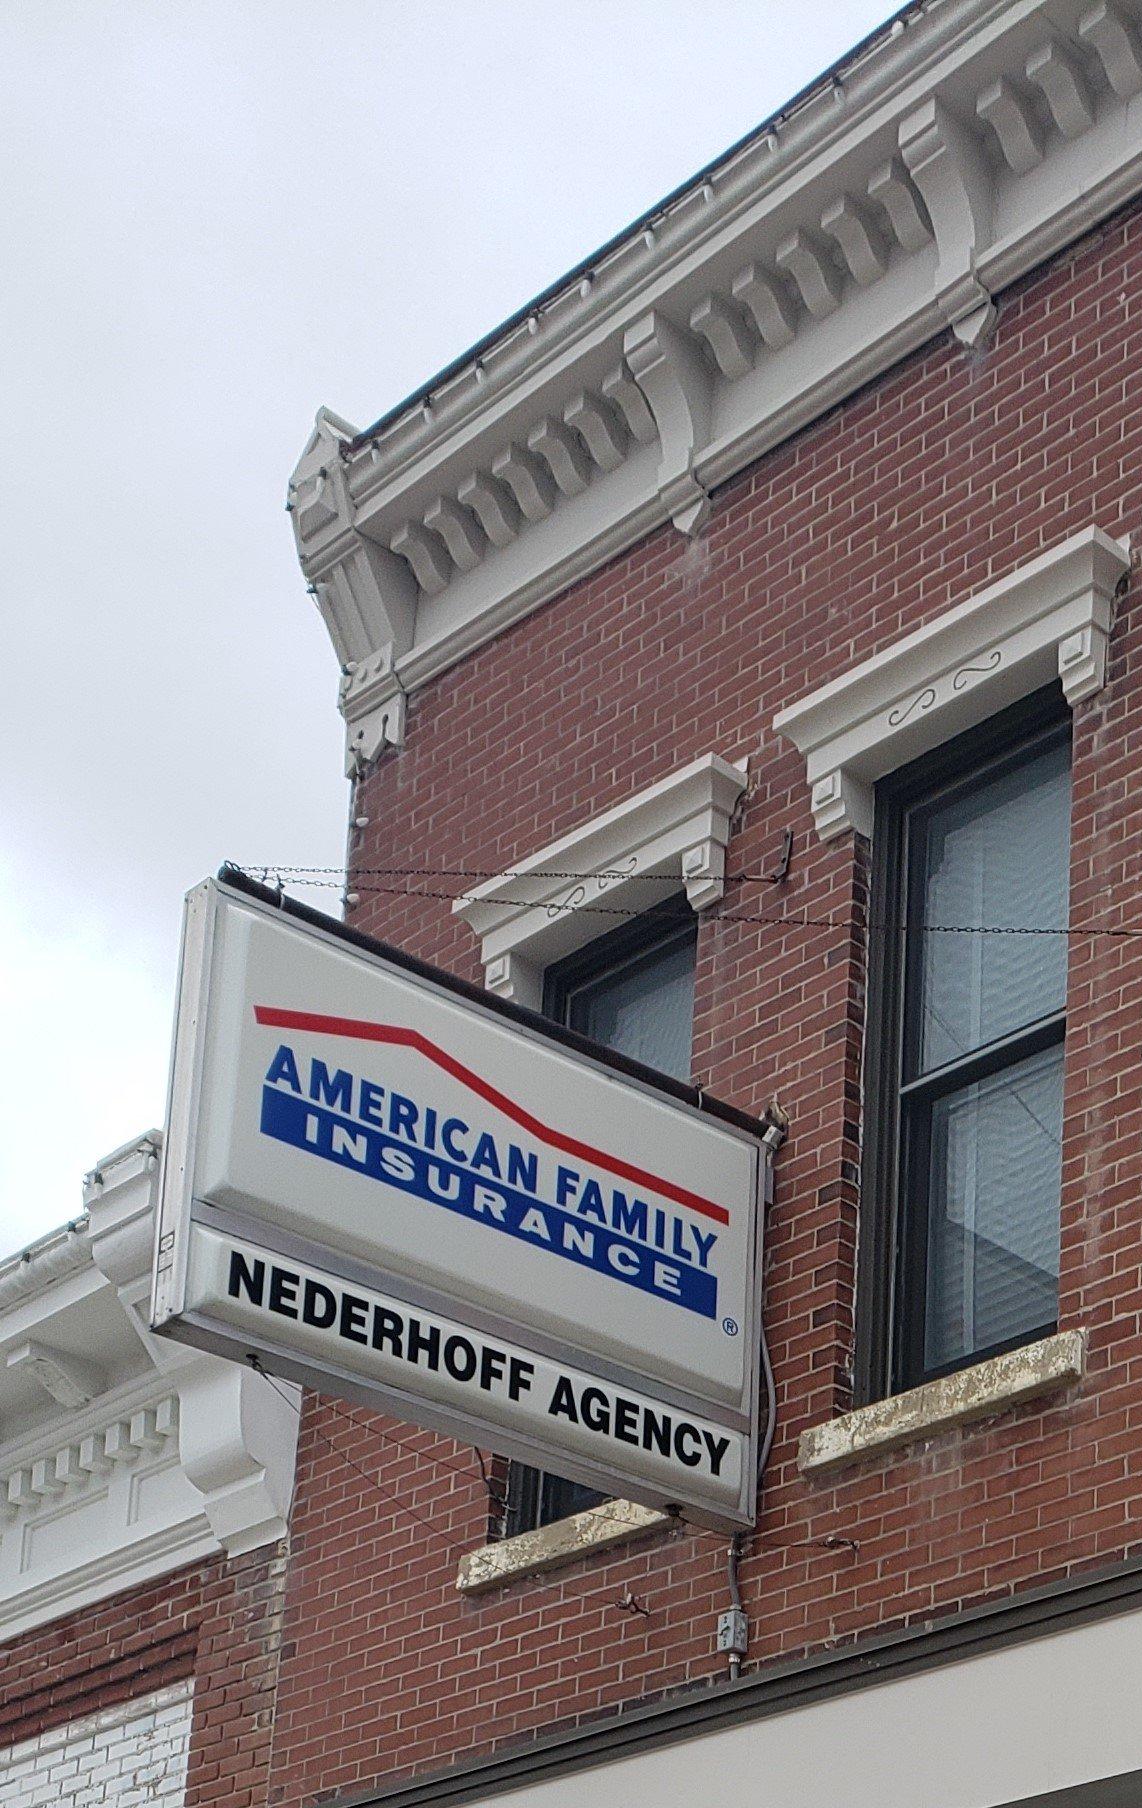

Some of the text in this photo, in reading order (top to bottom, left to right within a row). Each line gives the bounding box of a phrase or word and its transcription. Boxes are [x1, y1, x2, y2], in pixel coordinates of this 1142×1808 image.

[265, 1044, 718, 1269] AMERICAN FAMILY
[304, 1114, 683, 1297] INSURANCE
[227, 1249, 731, 1477] NEDERHOFF AGENCY
